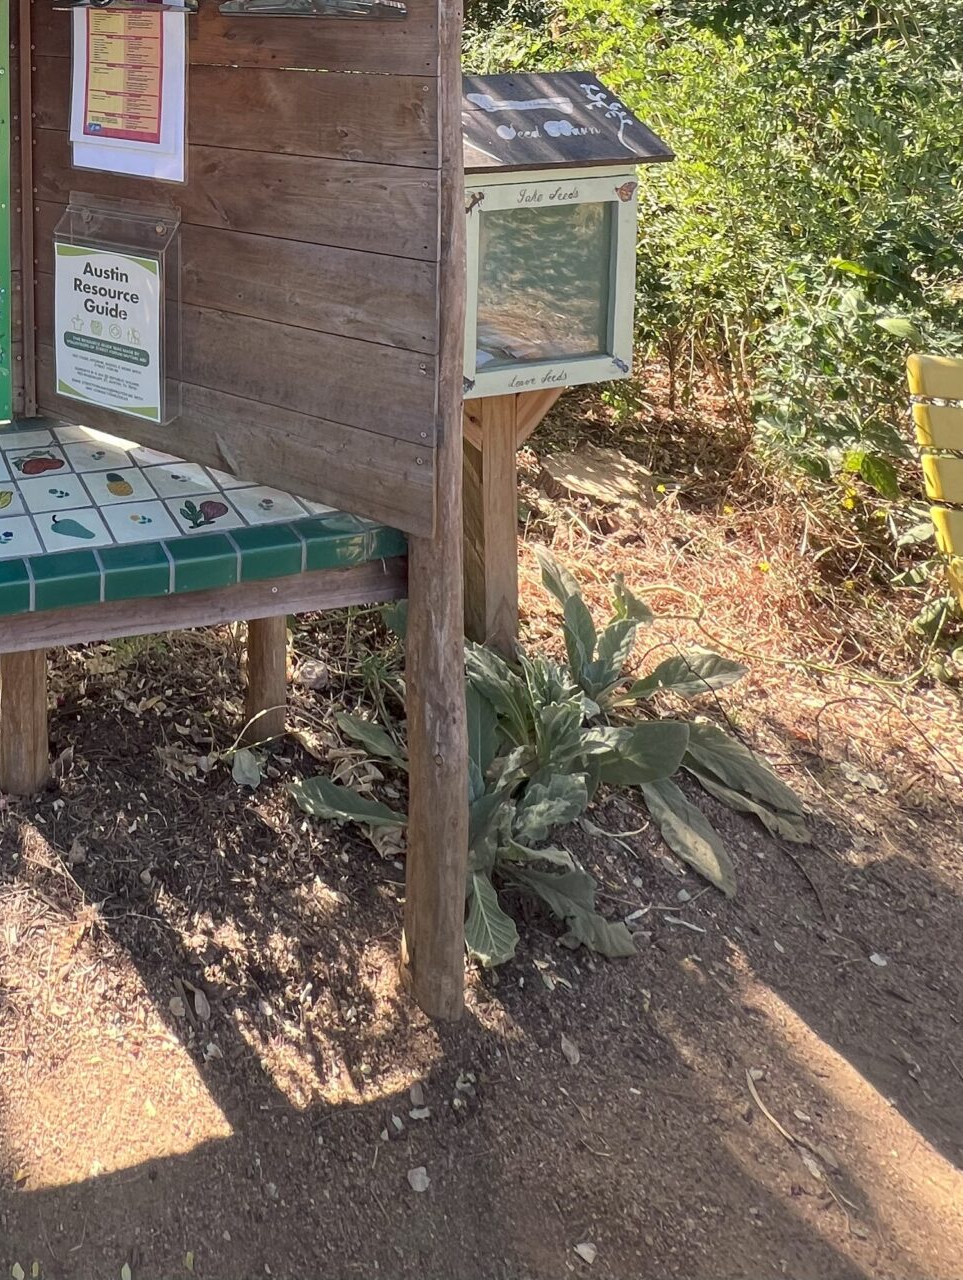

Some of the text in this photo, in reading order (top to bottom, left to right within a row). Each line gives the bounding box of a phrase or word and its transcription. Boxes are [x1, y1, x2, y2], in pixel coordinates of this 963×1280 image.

[517, 187, 579, 203] Take Seeds
[83, 262, 129, 283] Austin
[73, 277, 140, 304] Resource
[84, 298, 128, 320] Guide
